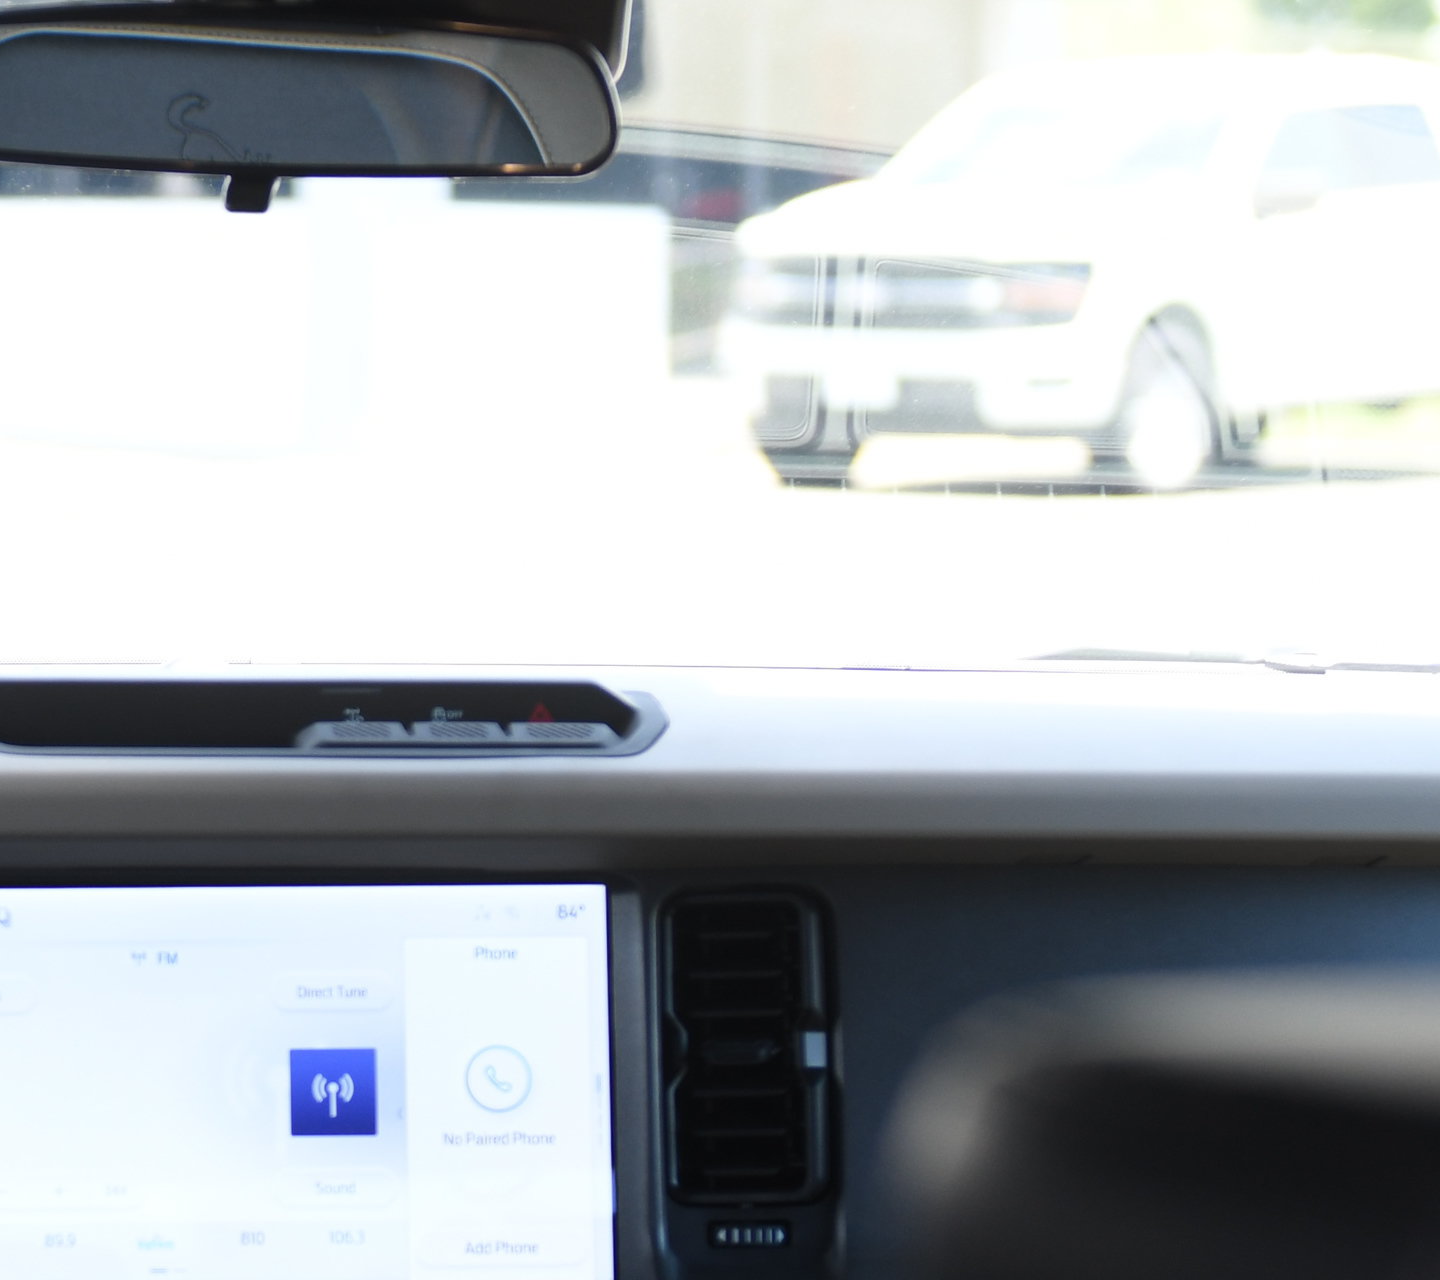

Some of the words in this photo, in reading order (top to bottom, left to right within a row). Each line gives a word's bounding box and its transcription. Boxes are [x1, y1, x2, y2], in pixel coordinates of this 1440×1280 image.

[474, 945, 519, 960] Phone
[296, 985, 333, 1000] Direct
[336, 985, 368, 1000] Tune
[443, 1131, 463, 1146] No
[466, 1131, 510, 1146] Paired
[512, 1131, 557, 1146] Phone
[495, 1240, 539, 1256] Phone
